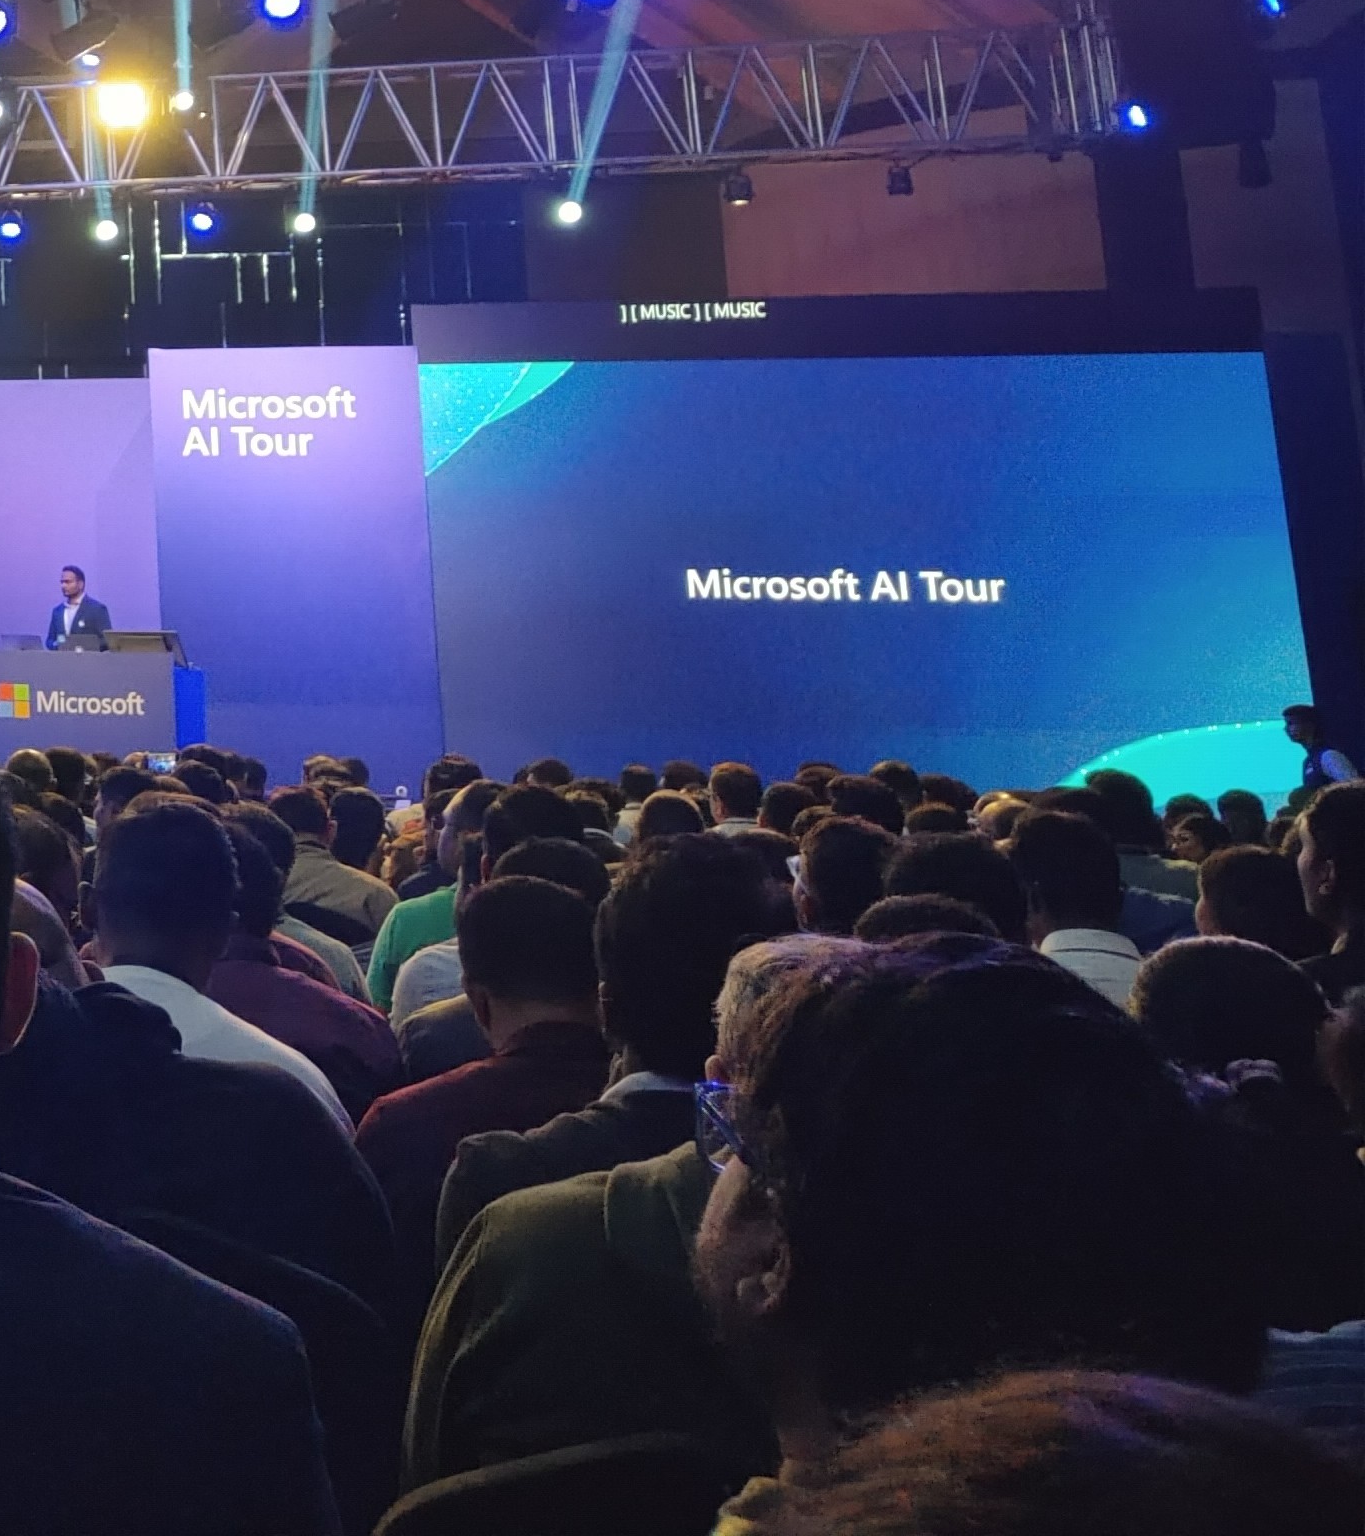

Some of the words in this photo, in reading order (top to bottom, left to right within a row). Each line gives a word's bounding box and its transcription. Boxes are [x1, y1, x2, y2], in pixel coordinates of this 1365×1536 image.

[714, 301, 767, 319] MUSIC
[181, 385, 357, 420] Microsoft
[181, 426, 220, 457] AI
[230, 425, 314, 457] Tour
[685, 567, 862, 602] Microsoft
[869, 569, 910, 602] AI
[917, 570, 1006, 604] Tour
[36, 689, 145, 716] Microsoft
